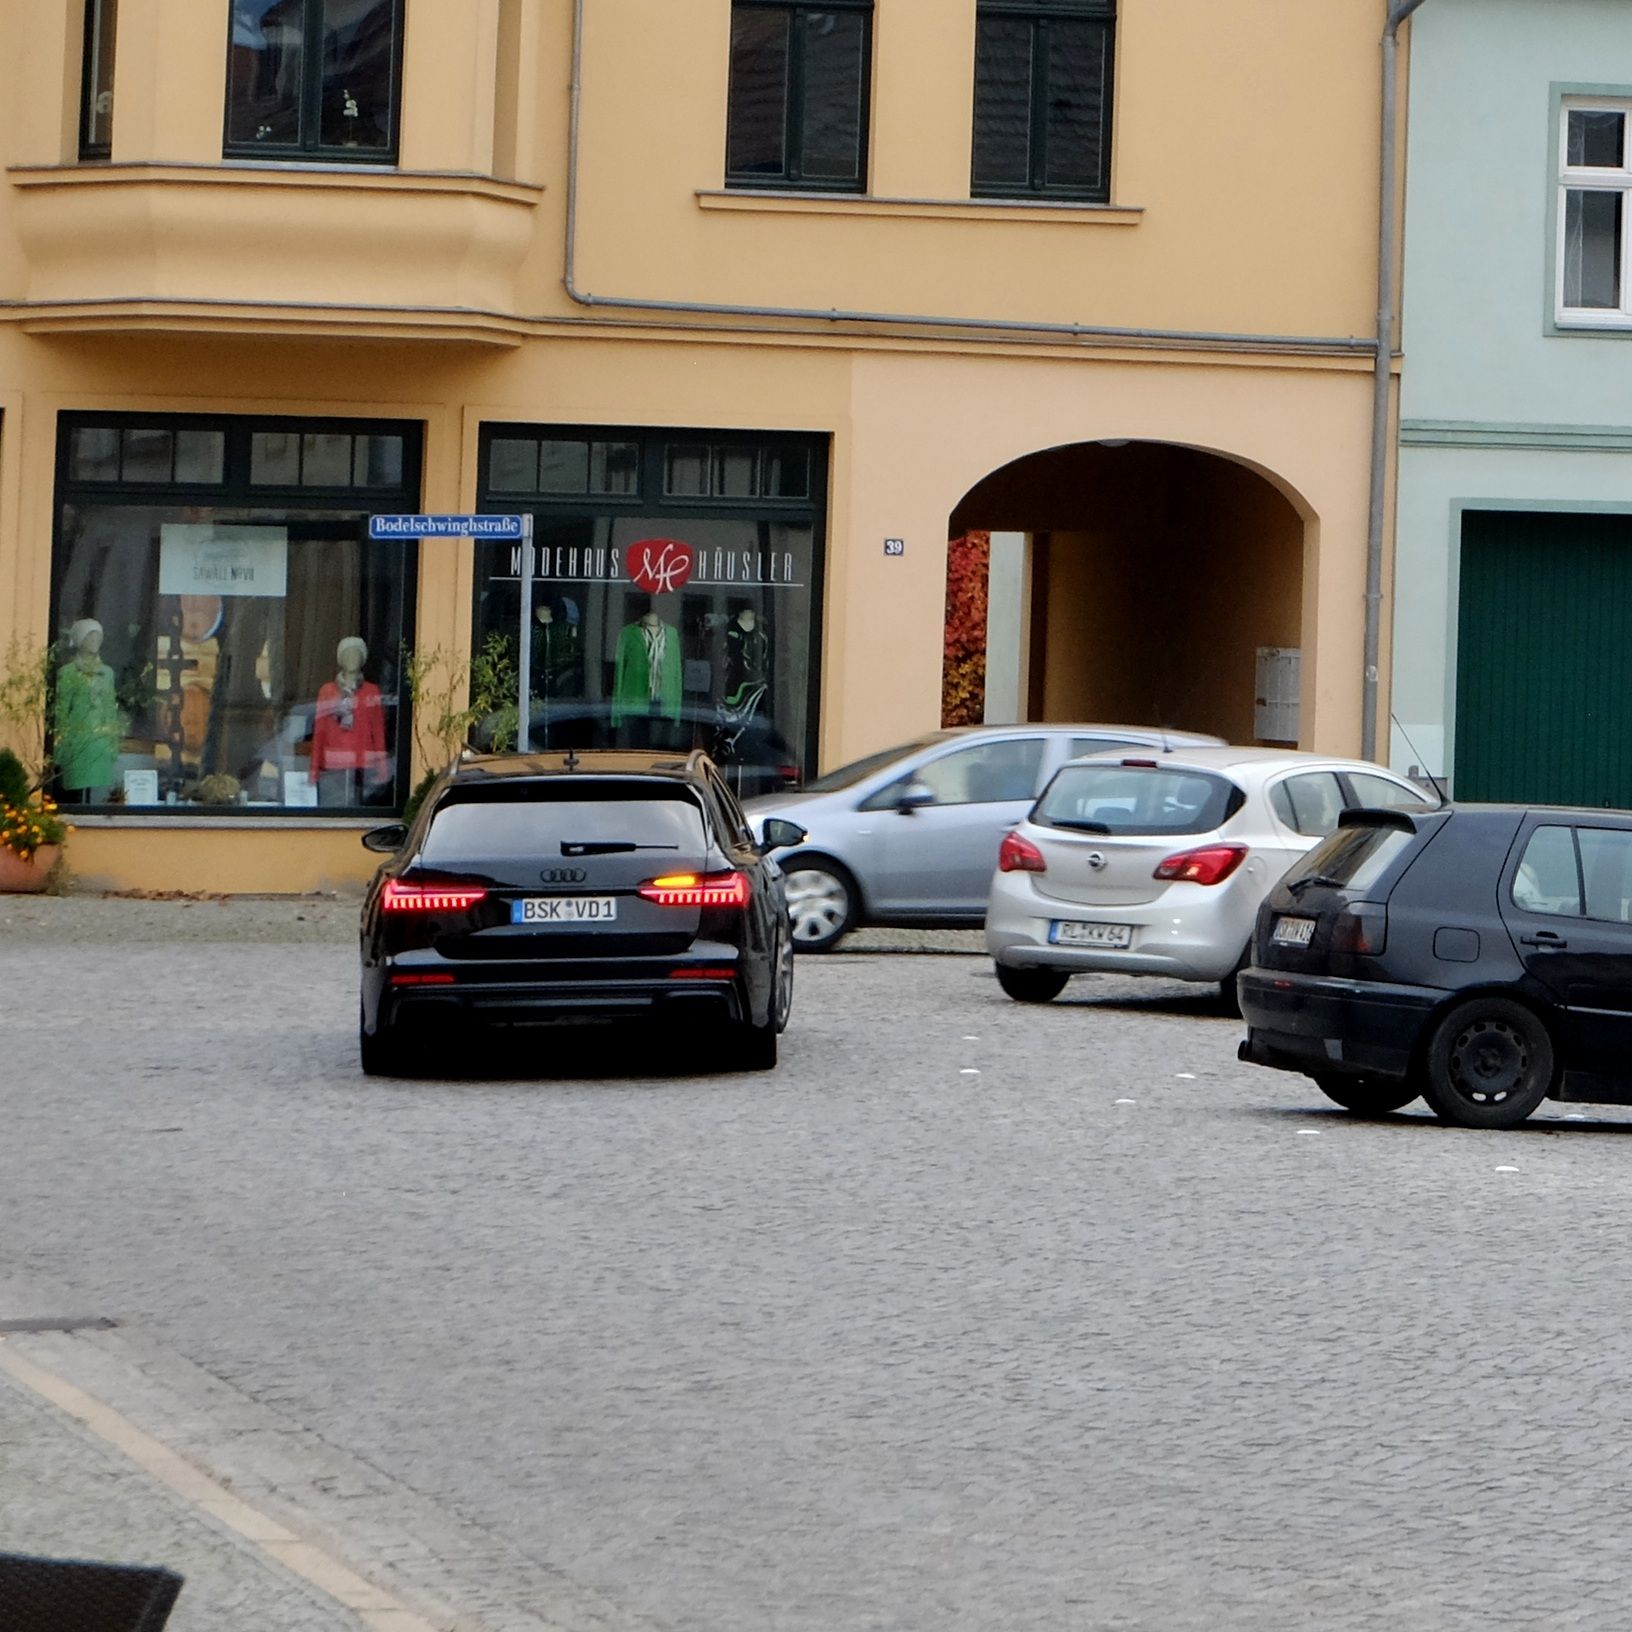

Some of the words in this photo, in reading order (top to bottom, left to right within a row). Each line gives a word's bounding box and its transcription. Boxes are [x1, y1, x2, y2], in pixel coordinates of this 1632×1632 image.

[375, 517, 518, 536] Bodelschwinghstraße
[886, 541, 902, 555] 39
[698, 545, 793, 581] HÄUSLER
[524, 900, 561, 919] BSK
